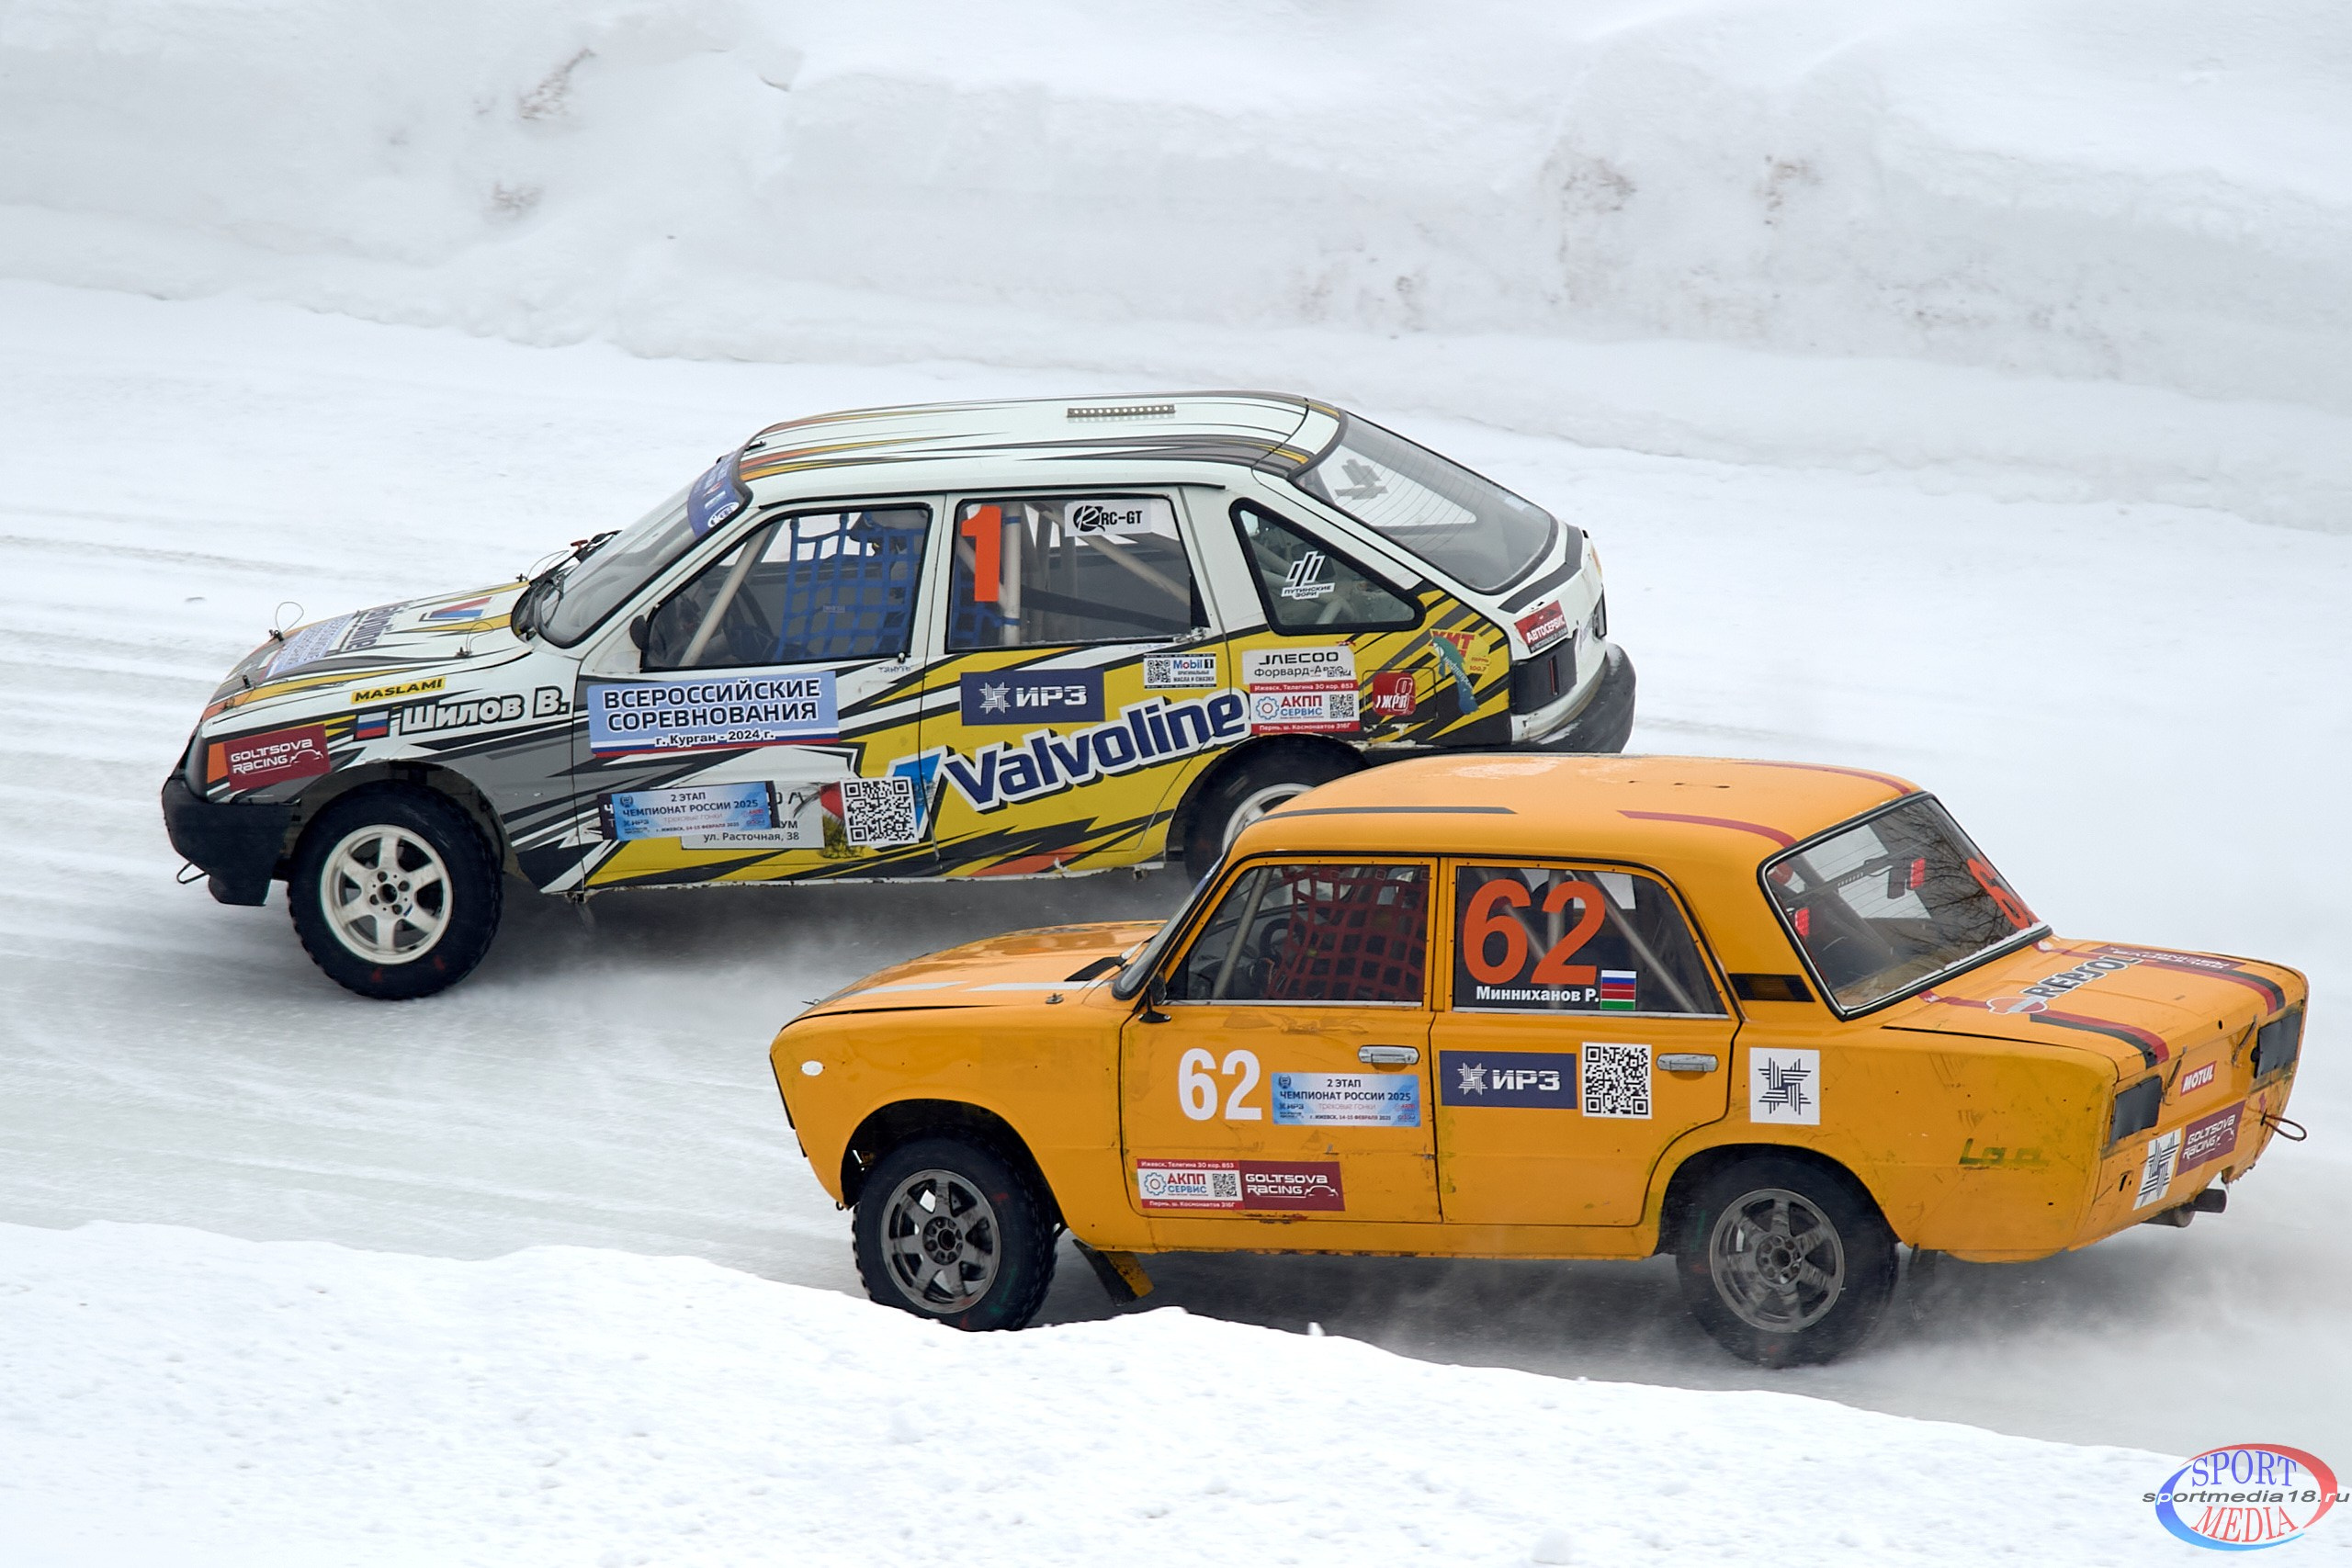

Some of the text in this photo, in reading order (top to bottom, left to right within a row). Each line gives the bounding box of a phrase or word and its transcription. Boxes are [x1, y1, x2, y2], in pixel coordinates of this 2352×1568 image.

[960, 504, 1002, 603] 1
[1173, 659, 1203, 670] Mobil
[355, 678, 443, 702] MASLAMI
[604, 679, 820, 709] ВСЕРОССИЙСКИЕ
[1015, 684, 1088, 707] ИРЗ
[401, 687, 569, 734] Шилов В.
[1280, 695, 1322, 707] АКПП
[608, 701, 817, 731] СОРЕВНОВАНИЯ
[1280, 707, 1323, 716] СЕРВИС
[655, 738, 666, 746] г.
[669, 734, 717, 748] Курган
[728, 729, 761, 740] 2024
[943, 693, 1246, 806] Valvoline
[671, 792, 706, 802] 2 ЭТАП
[622, 805, 687, 817] ЧЕМПИОНАТ
[689, 801, 731, 812] РОССИИ
[733, 799, 759, 808] 2025
[704, 831, 800, 843] ул. Расточная, 38
[1463, 878, 1606, 985] 62
[2020, 955, 2143, 998] REPSOL
[1476, 986, 1600, 1002] Минниханов Р.
[1178, 1047, 1262, 1121] 62
[1327, 1078, 1362, 1088] 2 ЭТАП
[1492, 1069, 1560, 1091] ИРЗ
[2182, 1064, 2214, 1093] MOTUL
[1280, 1090, 1411, 1101] ЧЕМПИОНАТ РОССИИ 2025
[1167, 1173, 1206, 1185] АКПП
[1167, 1185, 1207, 1193] СЕРВИС
